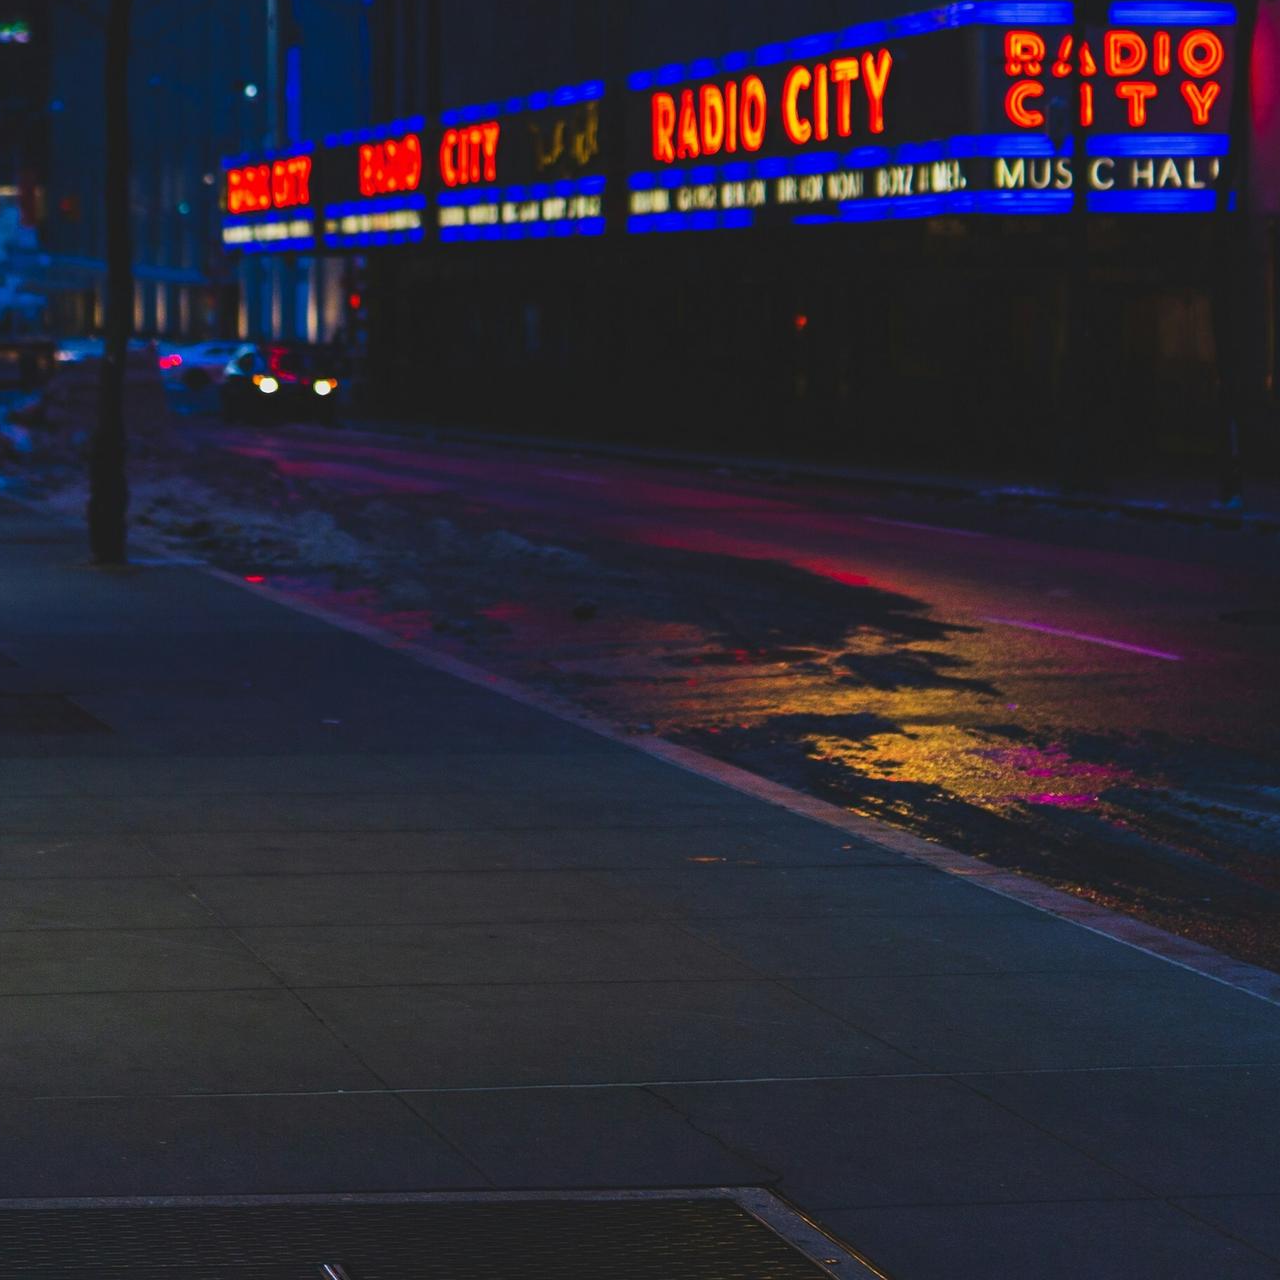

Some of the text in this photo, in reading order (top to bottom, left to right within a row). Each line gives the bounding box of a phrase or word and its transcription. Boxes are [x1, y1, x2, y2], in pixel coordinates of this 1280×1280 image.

[1004, 28, 1226, 78] RADIO
[650, 73, 768, 165] RADIO
[779, 47, 894, 146] CITY
[1004, 79, 1222, 128] CITY
[995, 157, 1115, 190] MUSC
